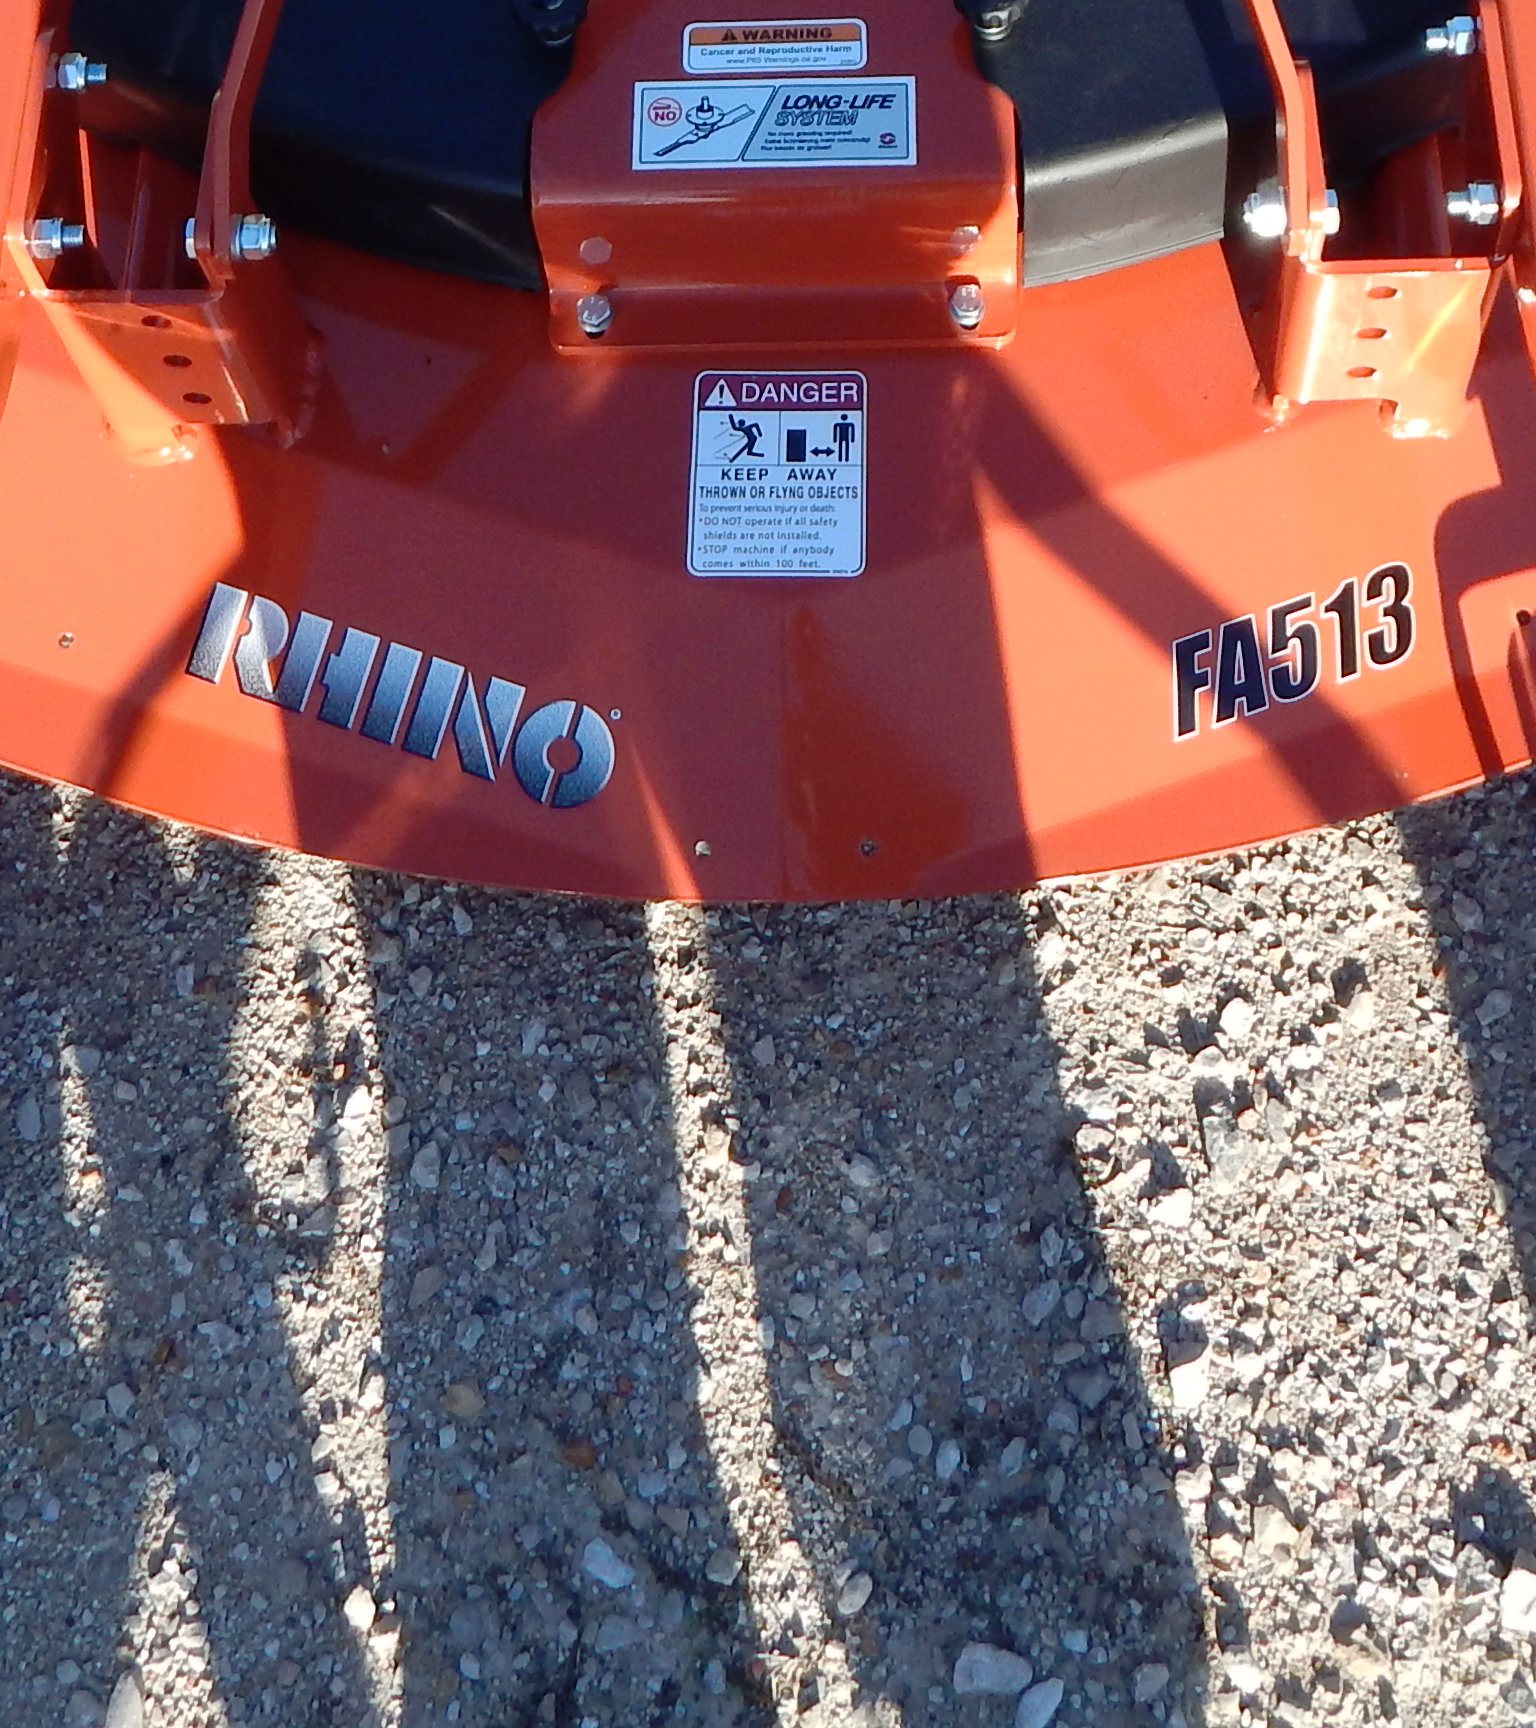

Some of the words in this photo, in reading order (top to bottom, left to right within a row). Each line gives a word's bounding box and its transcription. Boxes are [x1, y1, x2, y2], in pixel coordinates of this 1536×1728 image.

[742, 27, 833, 41] WARNING
[700, 47, 735, 57] Cancer
[737, 46, 756, 55] and
[758, 45, 823, 56] Reproductive
[825, 44, 852, 54] Harm
[781, 94, 896, 110] LONG-LIFE
[654, 110, 677, 121] NO
[774, 110, 859, 126] SYSTEM
[741, 382, 858, 403] DANGER
[721, 468, 769, 481] KEEP
[787, 468, 837, 481] AWAY
[699, 486, 746, 499] THROWN
[749, 486, 765, 499] OR
[769, 486, 804, 499] FLYNG
[808, 486, 858, 499] OBJECTS
[699, 503, 708, 512] To
[710, 503, 742, 514] prevent
[743, 503, 772, 512] serious
[774, 503, 797, 514] injury
[799, 505, 808, 513] or
[704, 517, 719, 526] DO
[722, 517, 742, 526] NOT
[744, 517, 782, 528] operate
[784, 517, 792, 526] if
[794, 517, 807, 526] all
[809, 517, 838, 527] safety
[703, 531, 737, 540] shields
[739, 532, 755, 540] are
[758, 532, 775, 540] not
[776, 531, 822, 540] installed.
[703, 545, 728, 554] STOP
[733, 545, 775, 554] machine
[780, 545, 787, 554] if
[792, 545, 835, 556] anybody
[702, 560, 734, 568] comes
[739, 559, 770, 568] within
[776, 559, 794, 568] 100
[798, 559, 821, 568] feet.
[1172, 561, 1416, 744] FA513
[186, 582, 616, 809] RHINO
